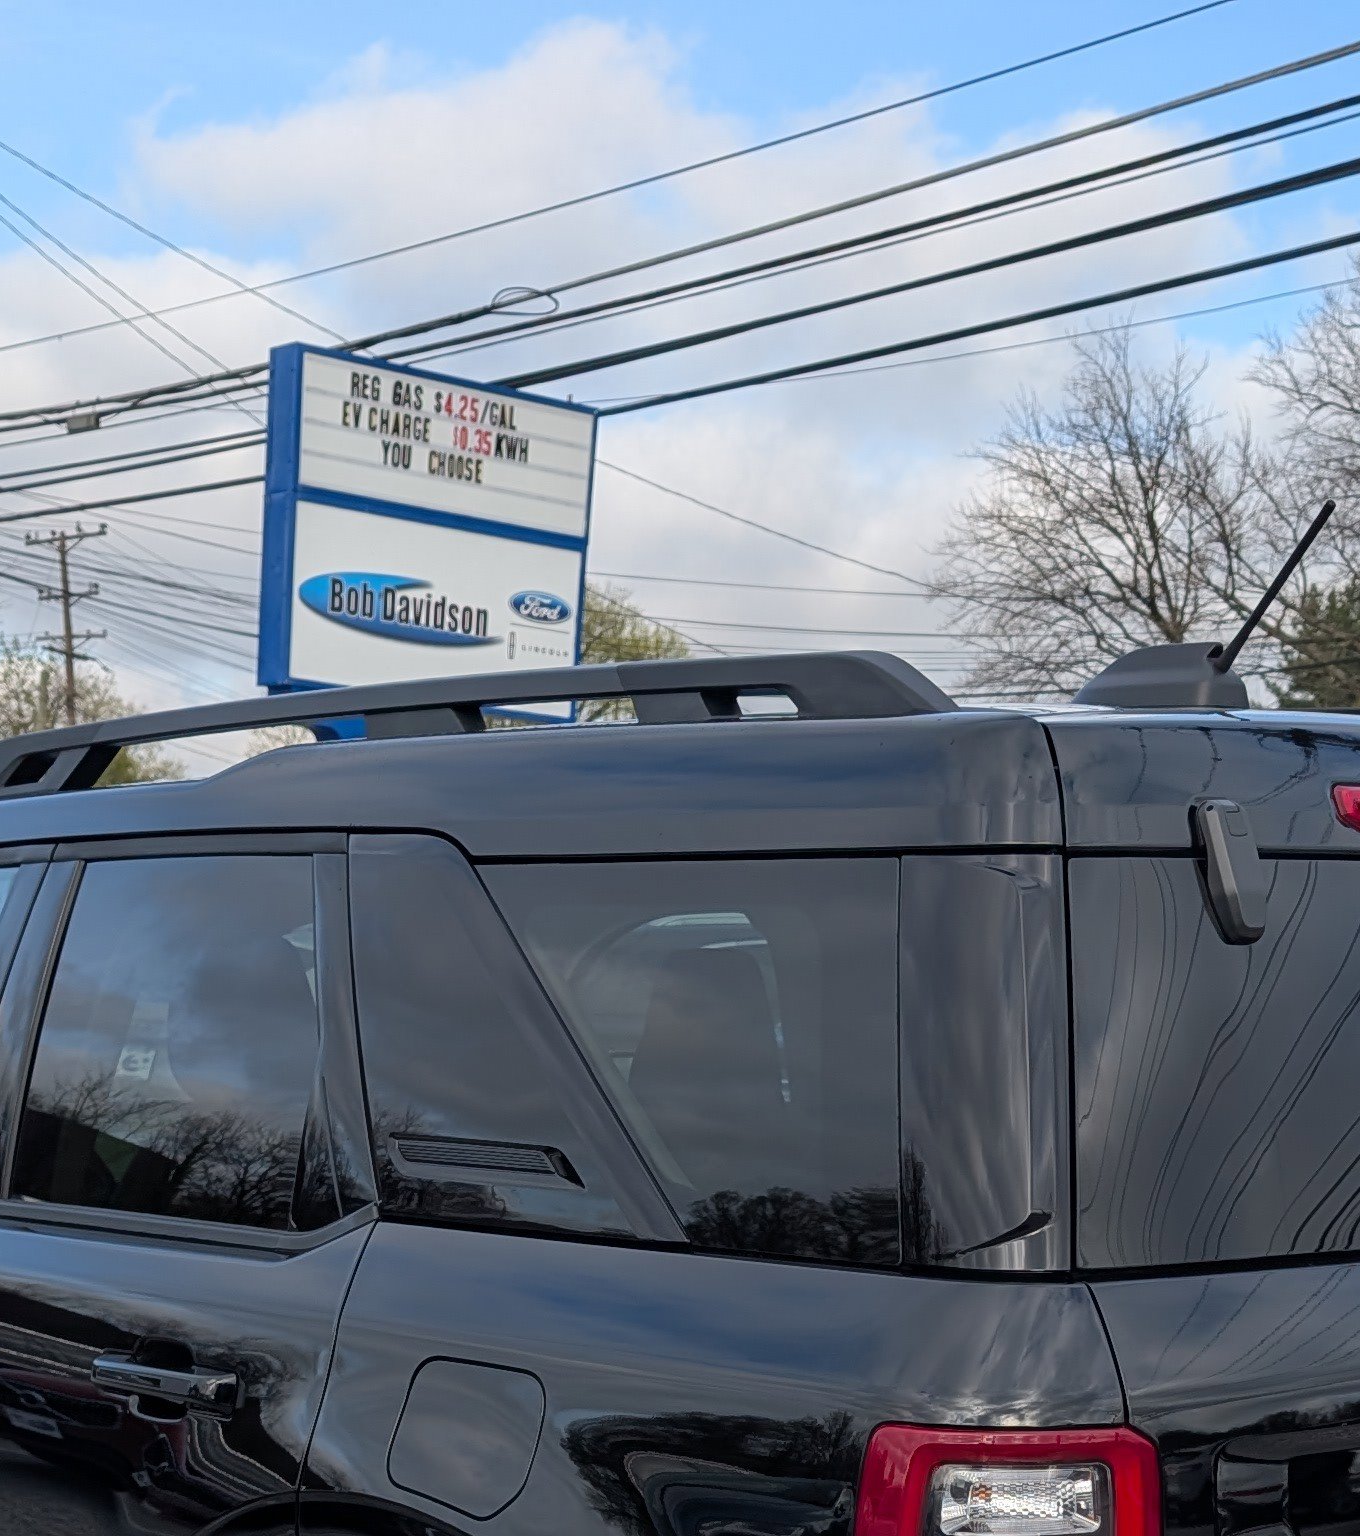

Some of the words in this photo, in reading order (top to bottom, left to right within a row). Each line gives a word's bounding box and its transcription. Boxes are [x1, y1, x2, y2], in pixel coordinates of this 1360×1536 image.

[351, 371, 381, 401] REG
[392, 379, 424, 411] GAS
[434, 391, 517, 431] $4.25/GAL
[343, 401, 362, 428] EV
[368, 407, 432, 443] CHARGE
[494, 432, 530, 464] KWH
[382, 439, 412, 470] YOU
[428, 450, 483, 484] CHOOSE
[330, 577, 374, 619] Bob
[381, 587, 489, 637] Davidson
[520, 595, 561, 619] Ford
